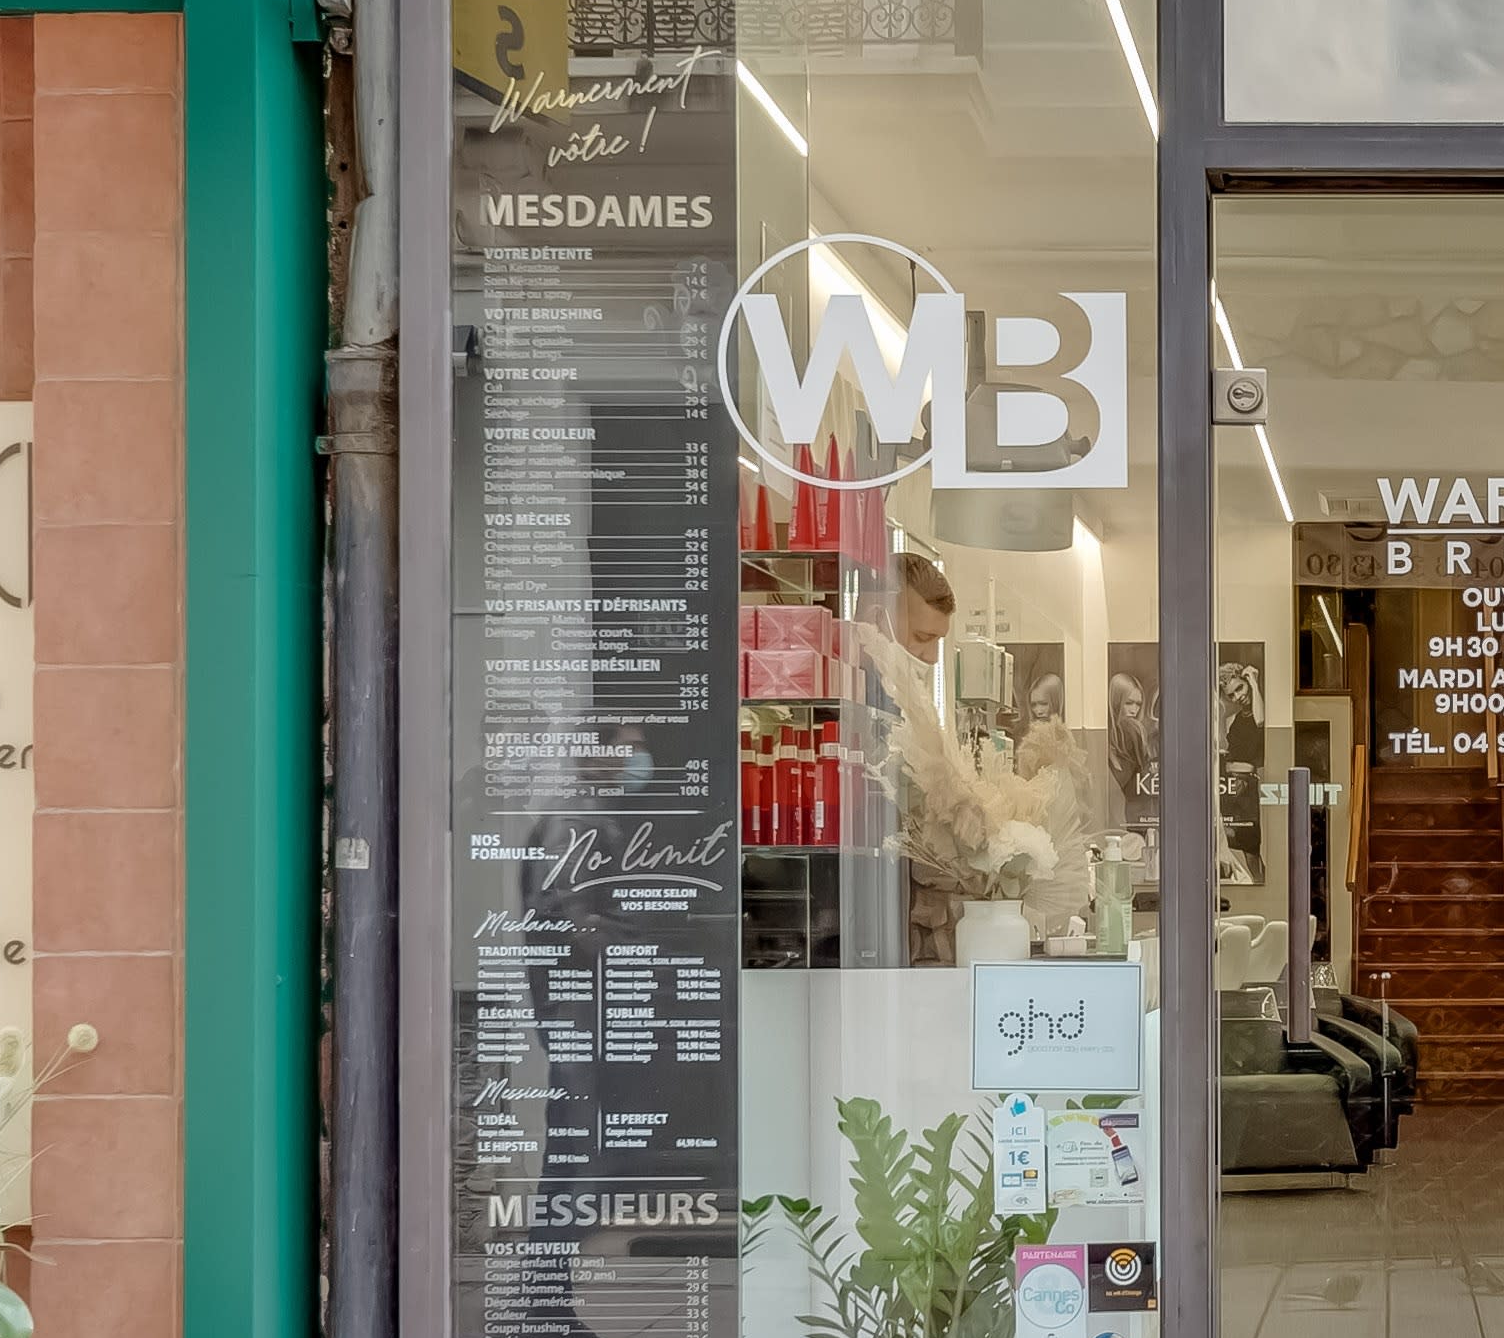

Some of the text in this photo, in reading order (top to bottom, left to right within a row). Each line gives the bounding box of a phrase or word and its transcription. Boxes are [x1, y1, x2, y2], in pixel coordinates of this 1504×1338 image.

[481, 194, 713, 228] MESDAMES
[483, 245, 593, 260] VOTRE DÉTENTE
[483, 308, 603, 321] VOTRE BRUSHING
[483, 368, 578, 380] VOTRE COUPE
[483, 428, 596, 440] VOTRE COULEUR
[1399, 669, 1483, 689] MARDI
[485, 733, 599, 745] VOTRE COIFFURE
[1389, 728, 1445, 754] TÉL.
[1453, 732, 1488, 754] 04
[471, 835, 501, 847] NOS
[622, 820, 734, 872] limit
[998, 998, 1084, 1056] ghd
[1008, 1150, 1031, 1166] 1€
[488, 1192, 719, 1228] MESSIEURS
[484, 1242, 581, 1255] VOS CHEVEUX
